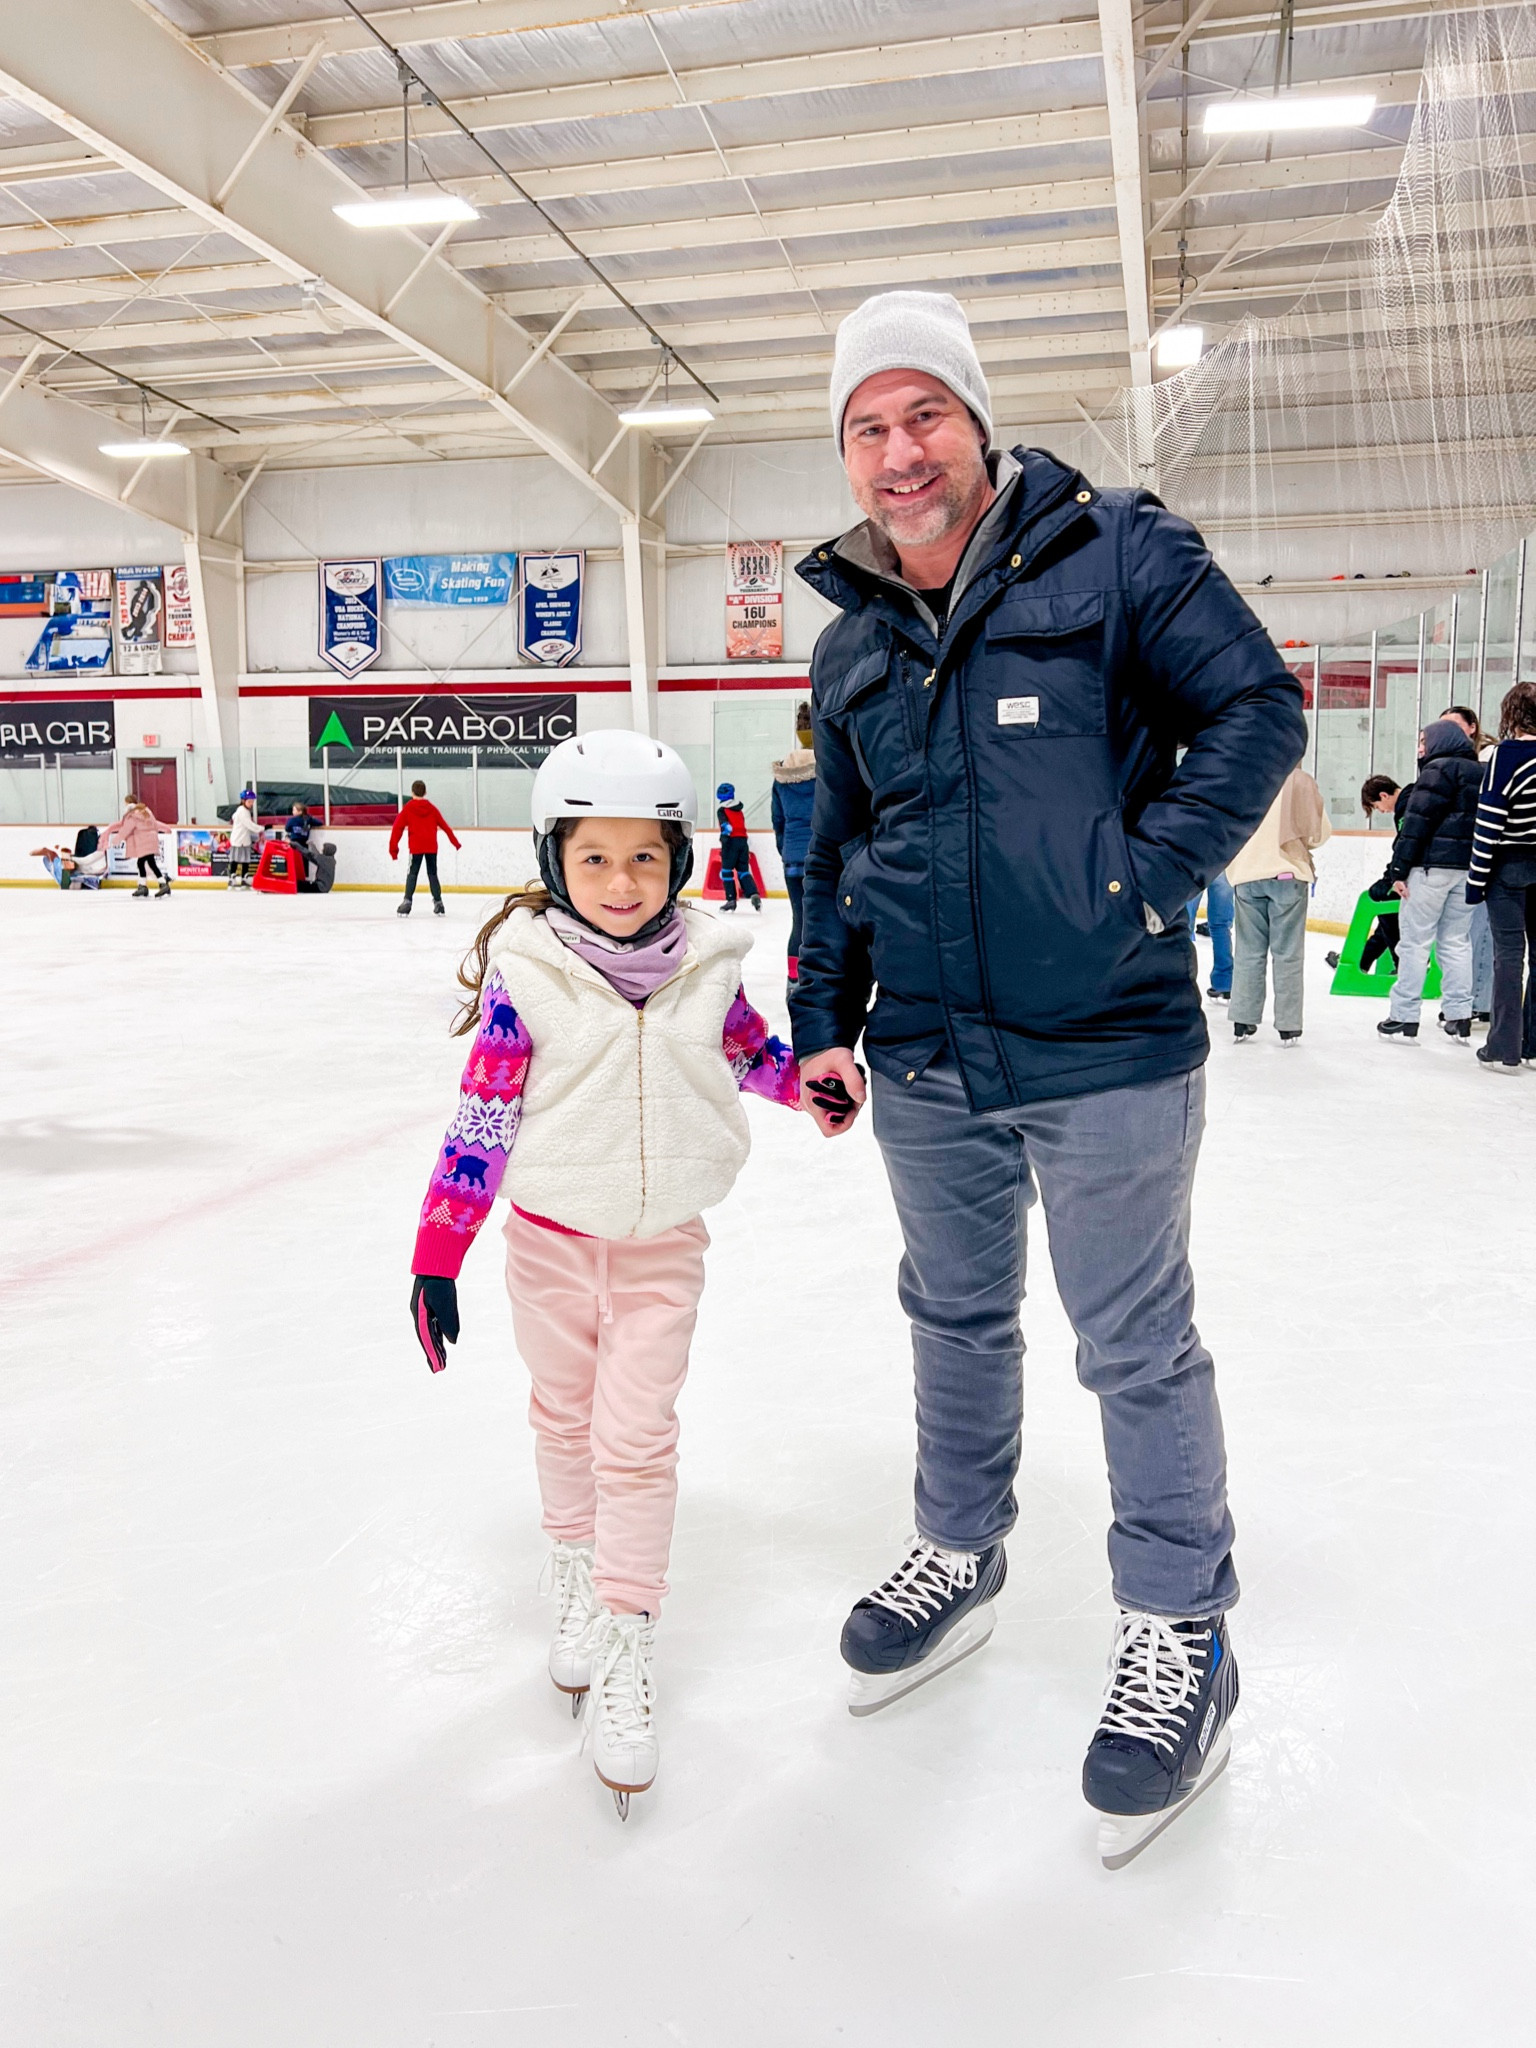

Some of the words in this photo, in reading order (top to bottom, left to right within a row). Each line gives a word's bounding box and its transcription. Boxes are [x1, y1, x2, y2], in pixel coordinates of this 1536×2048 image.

[452, 561, 490, 573] Making
[441, 578, 481, 590] Skating
[484, 576, 505, 587] Fun
[744, 595, 778, 604] DIVISION
[744, 606, 766, 618] 16U
[732, 620, 777, 629] CHAMPIONS
[363, 715, 573, 741] PARABOLIC
[658, 809, 682, 818] GIRO
